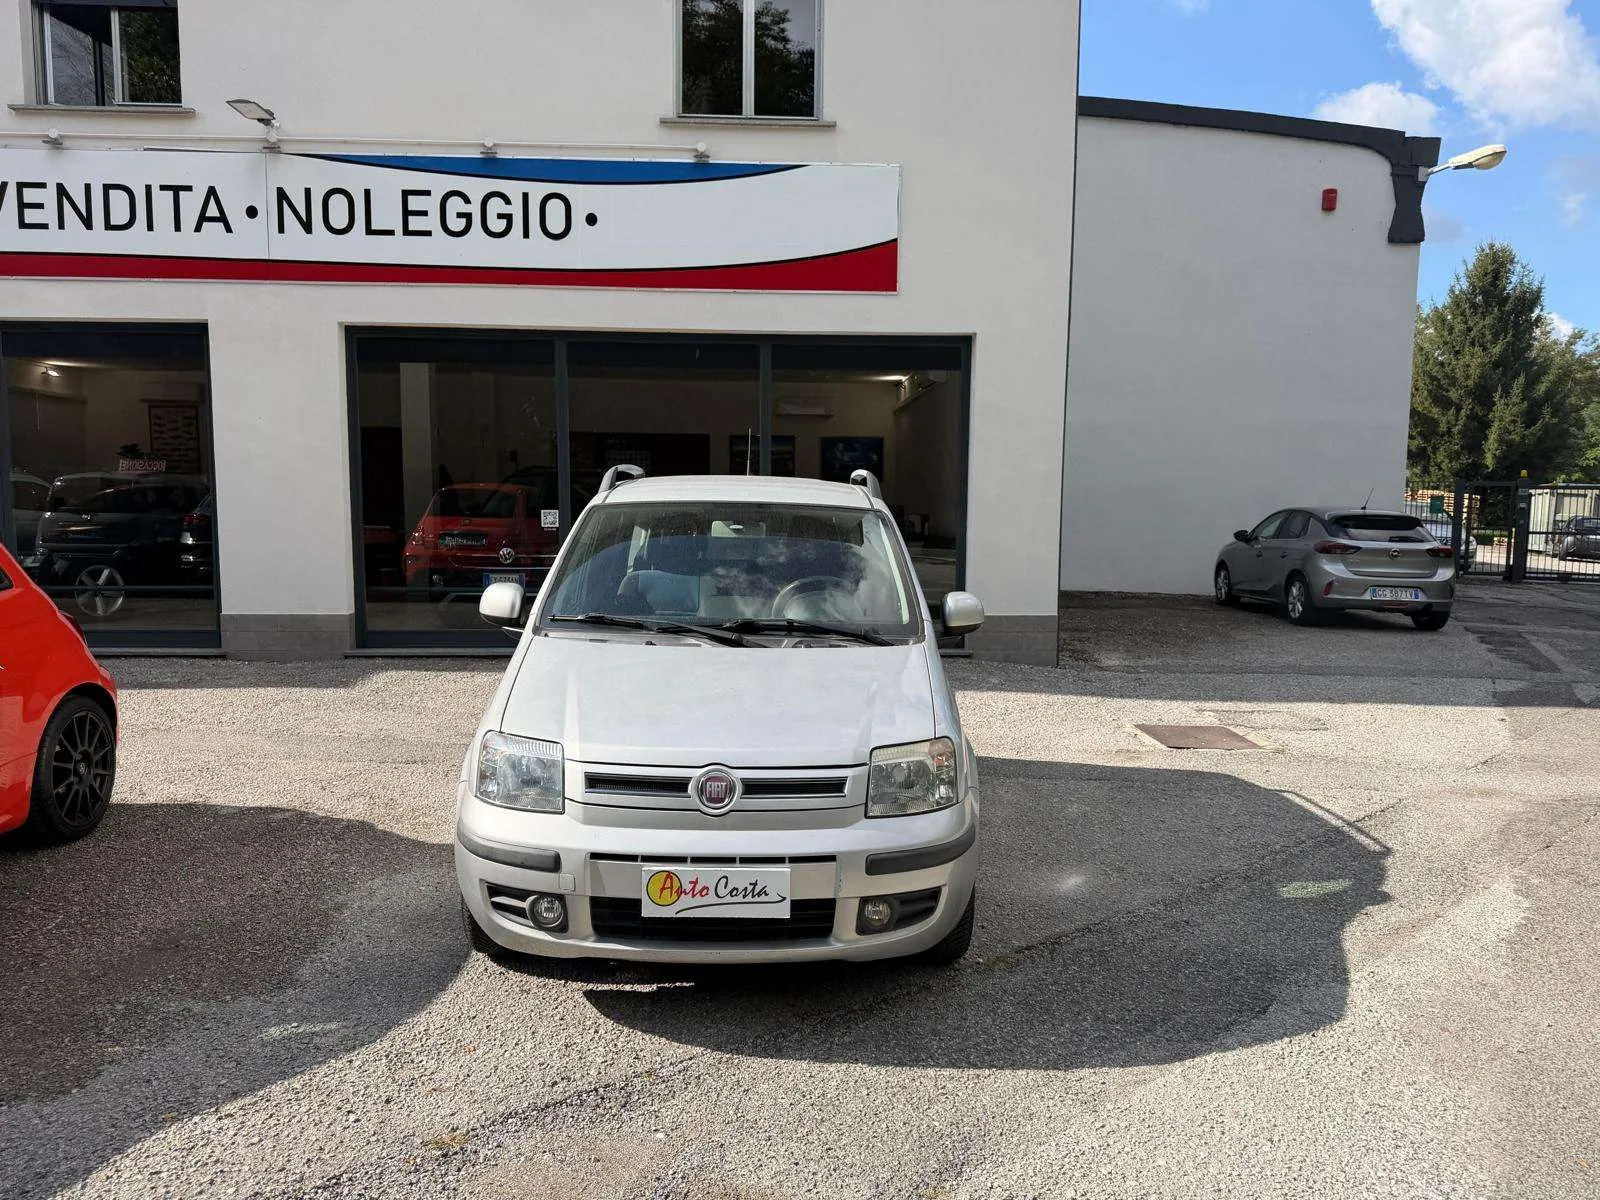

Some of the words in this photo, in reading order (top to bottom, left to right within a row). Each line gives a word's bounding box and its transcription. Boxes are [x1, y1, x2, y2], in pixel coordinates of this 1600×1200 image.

[276, 186, 573, 241] NOLEGGIO
[706, 781, 727, 798] FIAT
[659, 871, 710, 900] Auto
[714, 875, 770, 900] Costa
